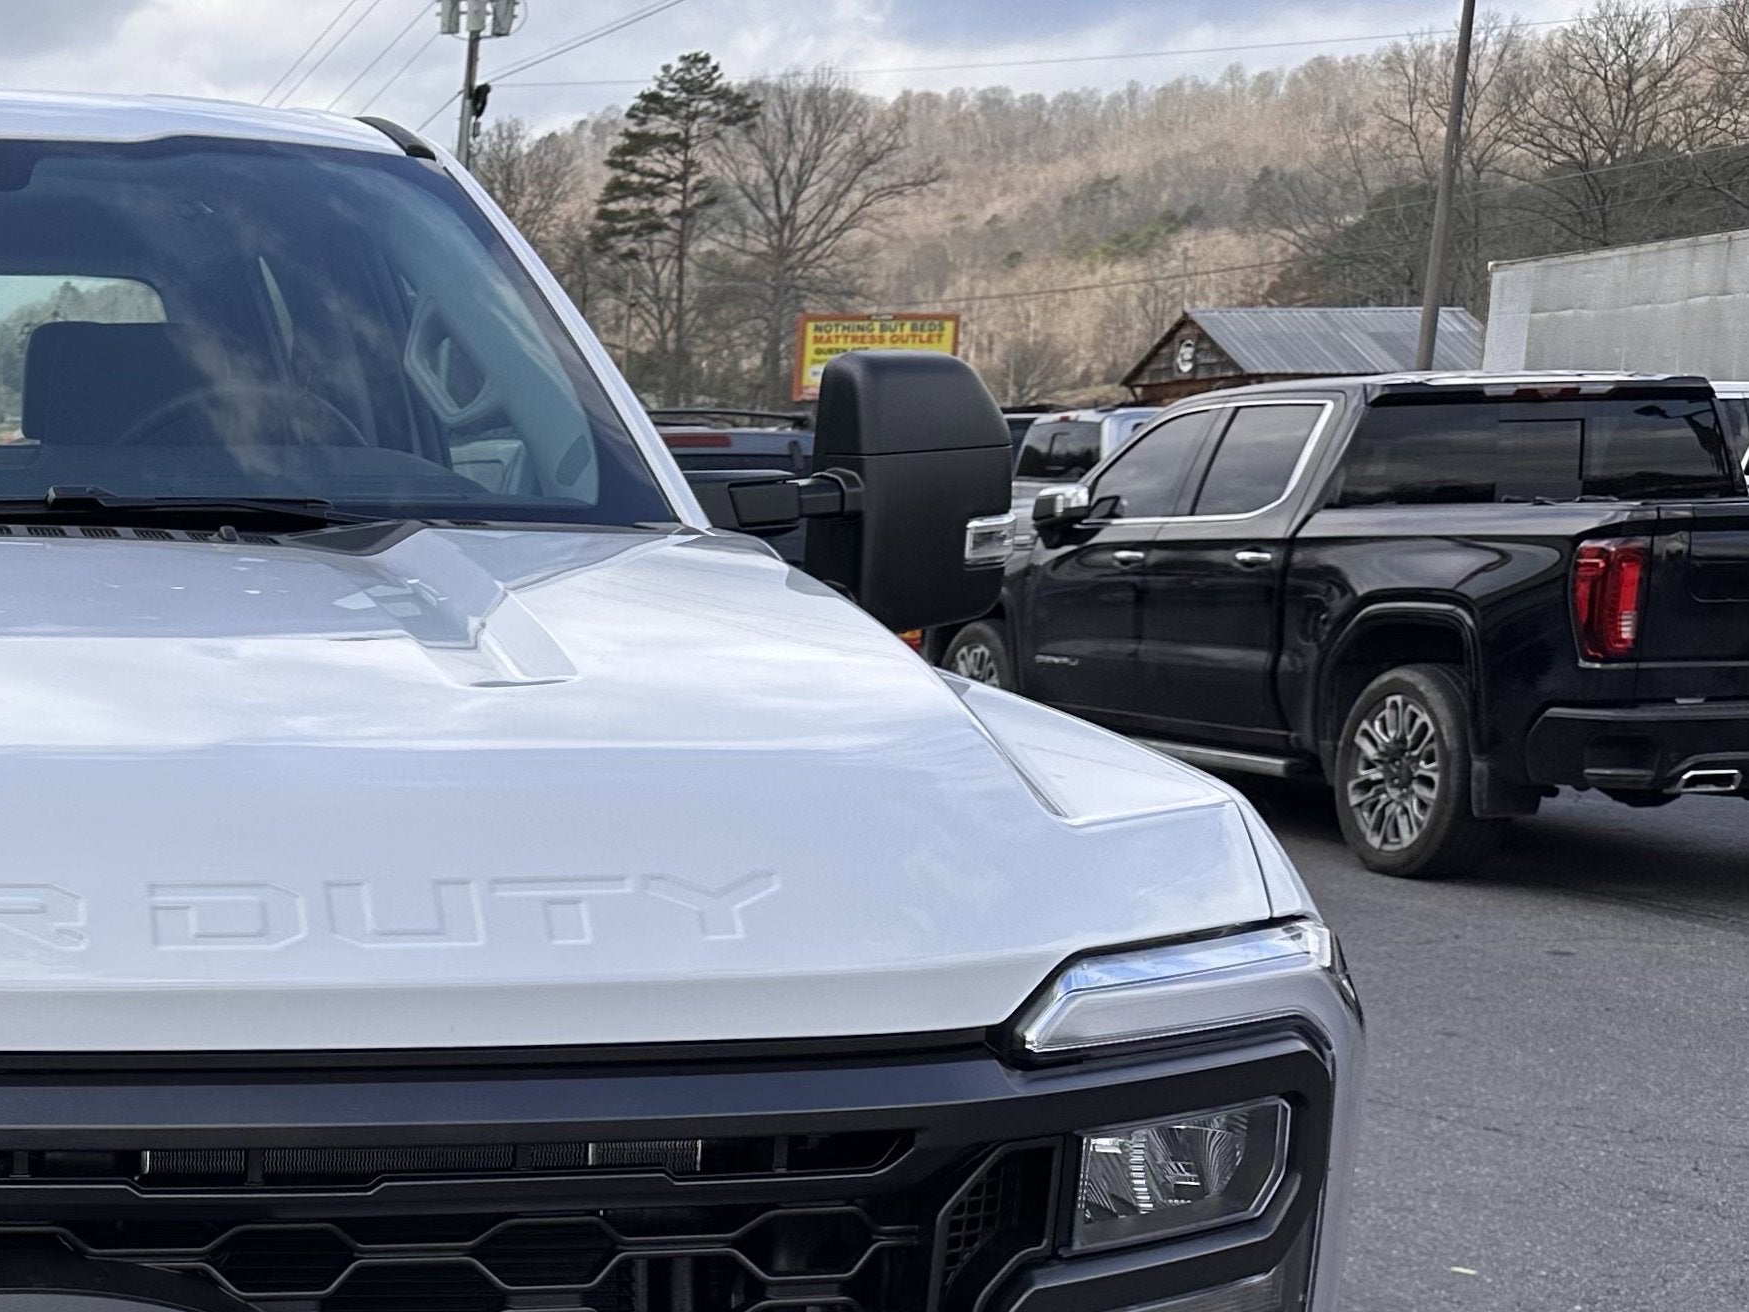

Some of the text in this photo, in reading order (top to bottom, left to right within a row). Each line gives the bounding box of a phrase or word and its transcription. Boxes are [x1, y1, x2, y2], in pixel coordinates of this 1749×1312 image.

[813, 322, 945, 333] NOTHING BUT BEDS
[812, 334, 943, 344] MATTRESS OUTLET
[147, 872, 782, 950] DUTY
